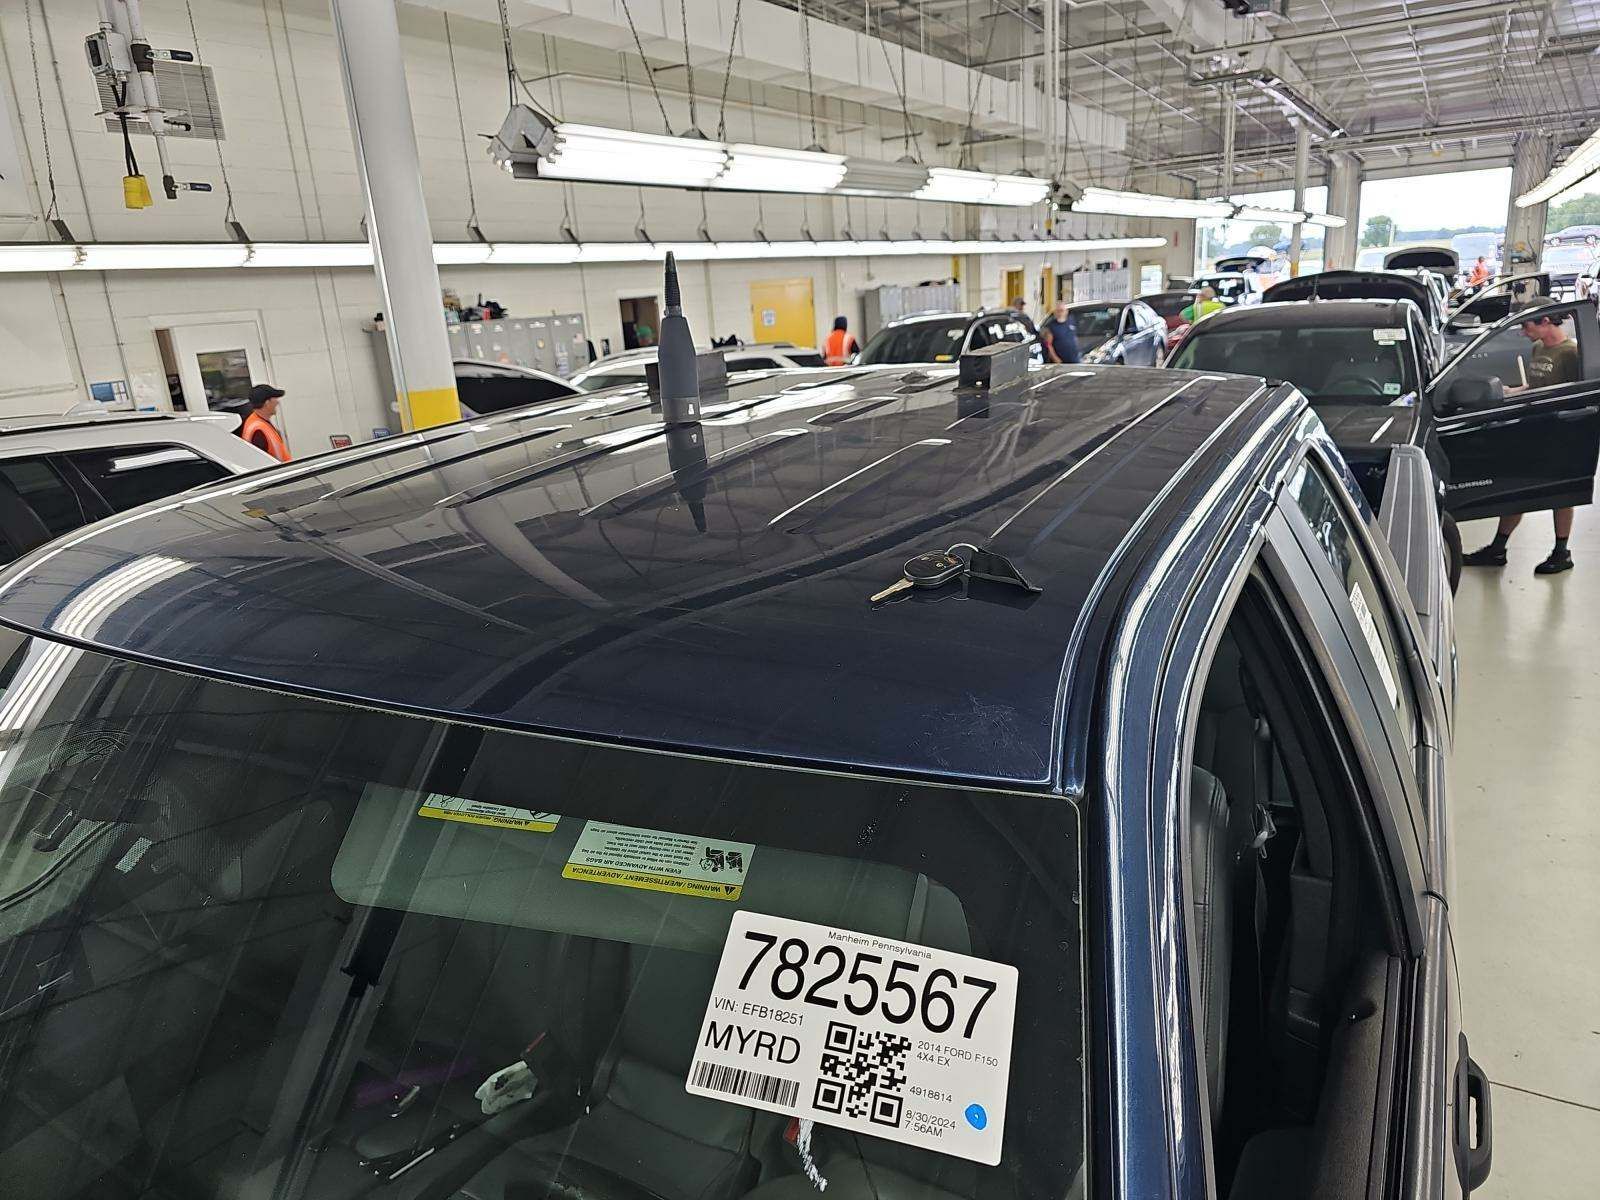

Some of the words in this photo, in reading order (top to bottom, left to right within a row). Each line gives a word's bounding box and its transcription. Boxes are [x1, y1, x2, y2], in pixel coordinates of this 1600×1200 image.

[615, 860, 647, 869] ADVANCED
[687, 882, 720, 892] WARNING
[828, 931, 870, 947] Manheim
[872, 939, 932, 960] Pennsylvania
[738, 931, 998, 1039] 7825567
[714, 996, 737, 1013] VIN:
[742, 1003, 803, 1026] EFB18251
[704, 1020, 801, 1065] MYRD
[916, 1052, 935, 1064] 4X4
[937, 1057, 950, 1067] EX
[917, 1041, 941, 1053] 2014
[943, 1046, 972, 1061] FORD
[975, 1053, 998, 1067] F150
[909, 1086, 952, 1103] 4918814
[904, 1120, 943, 1138] 7:56AM
[905, 1110, 956, 1130] 8/30/2024
